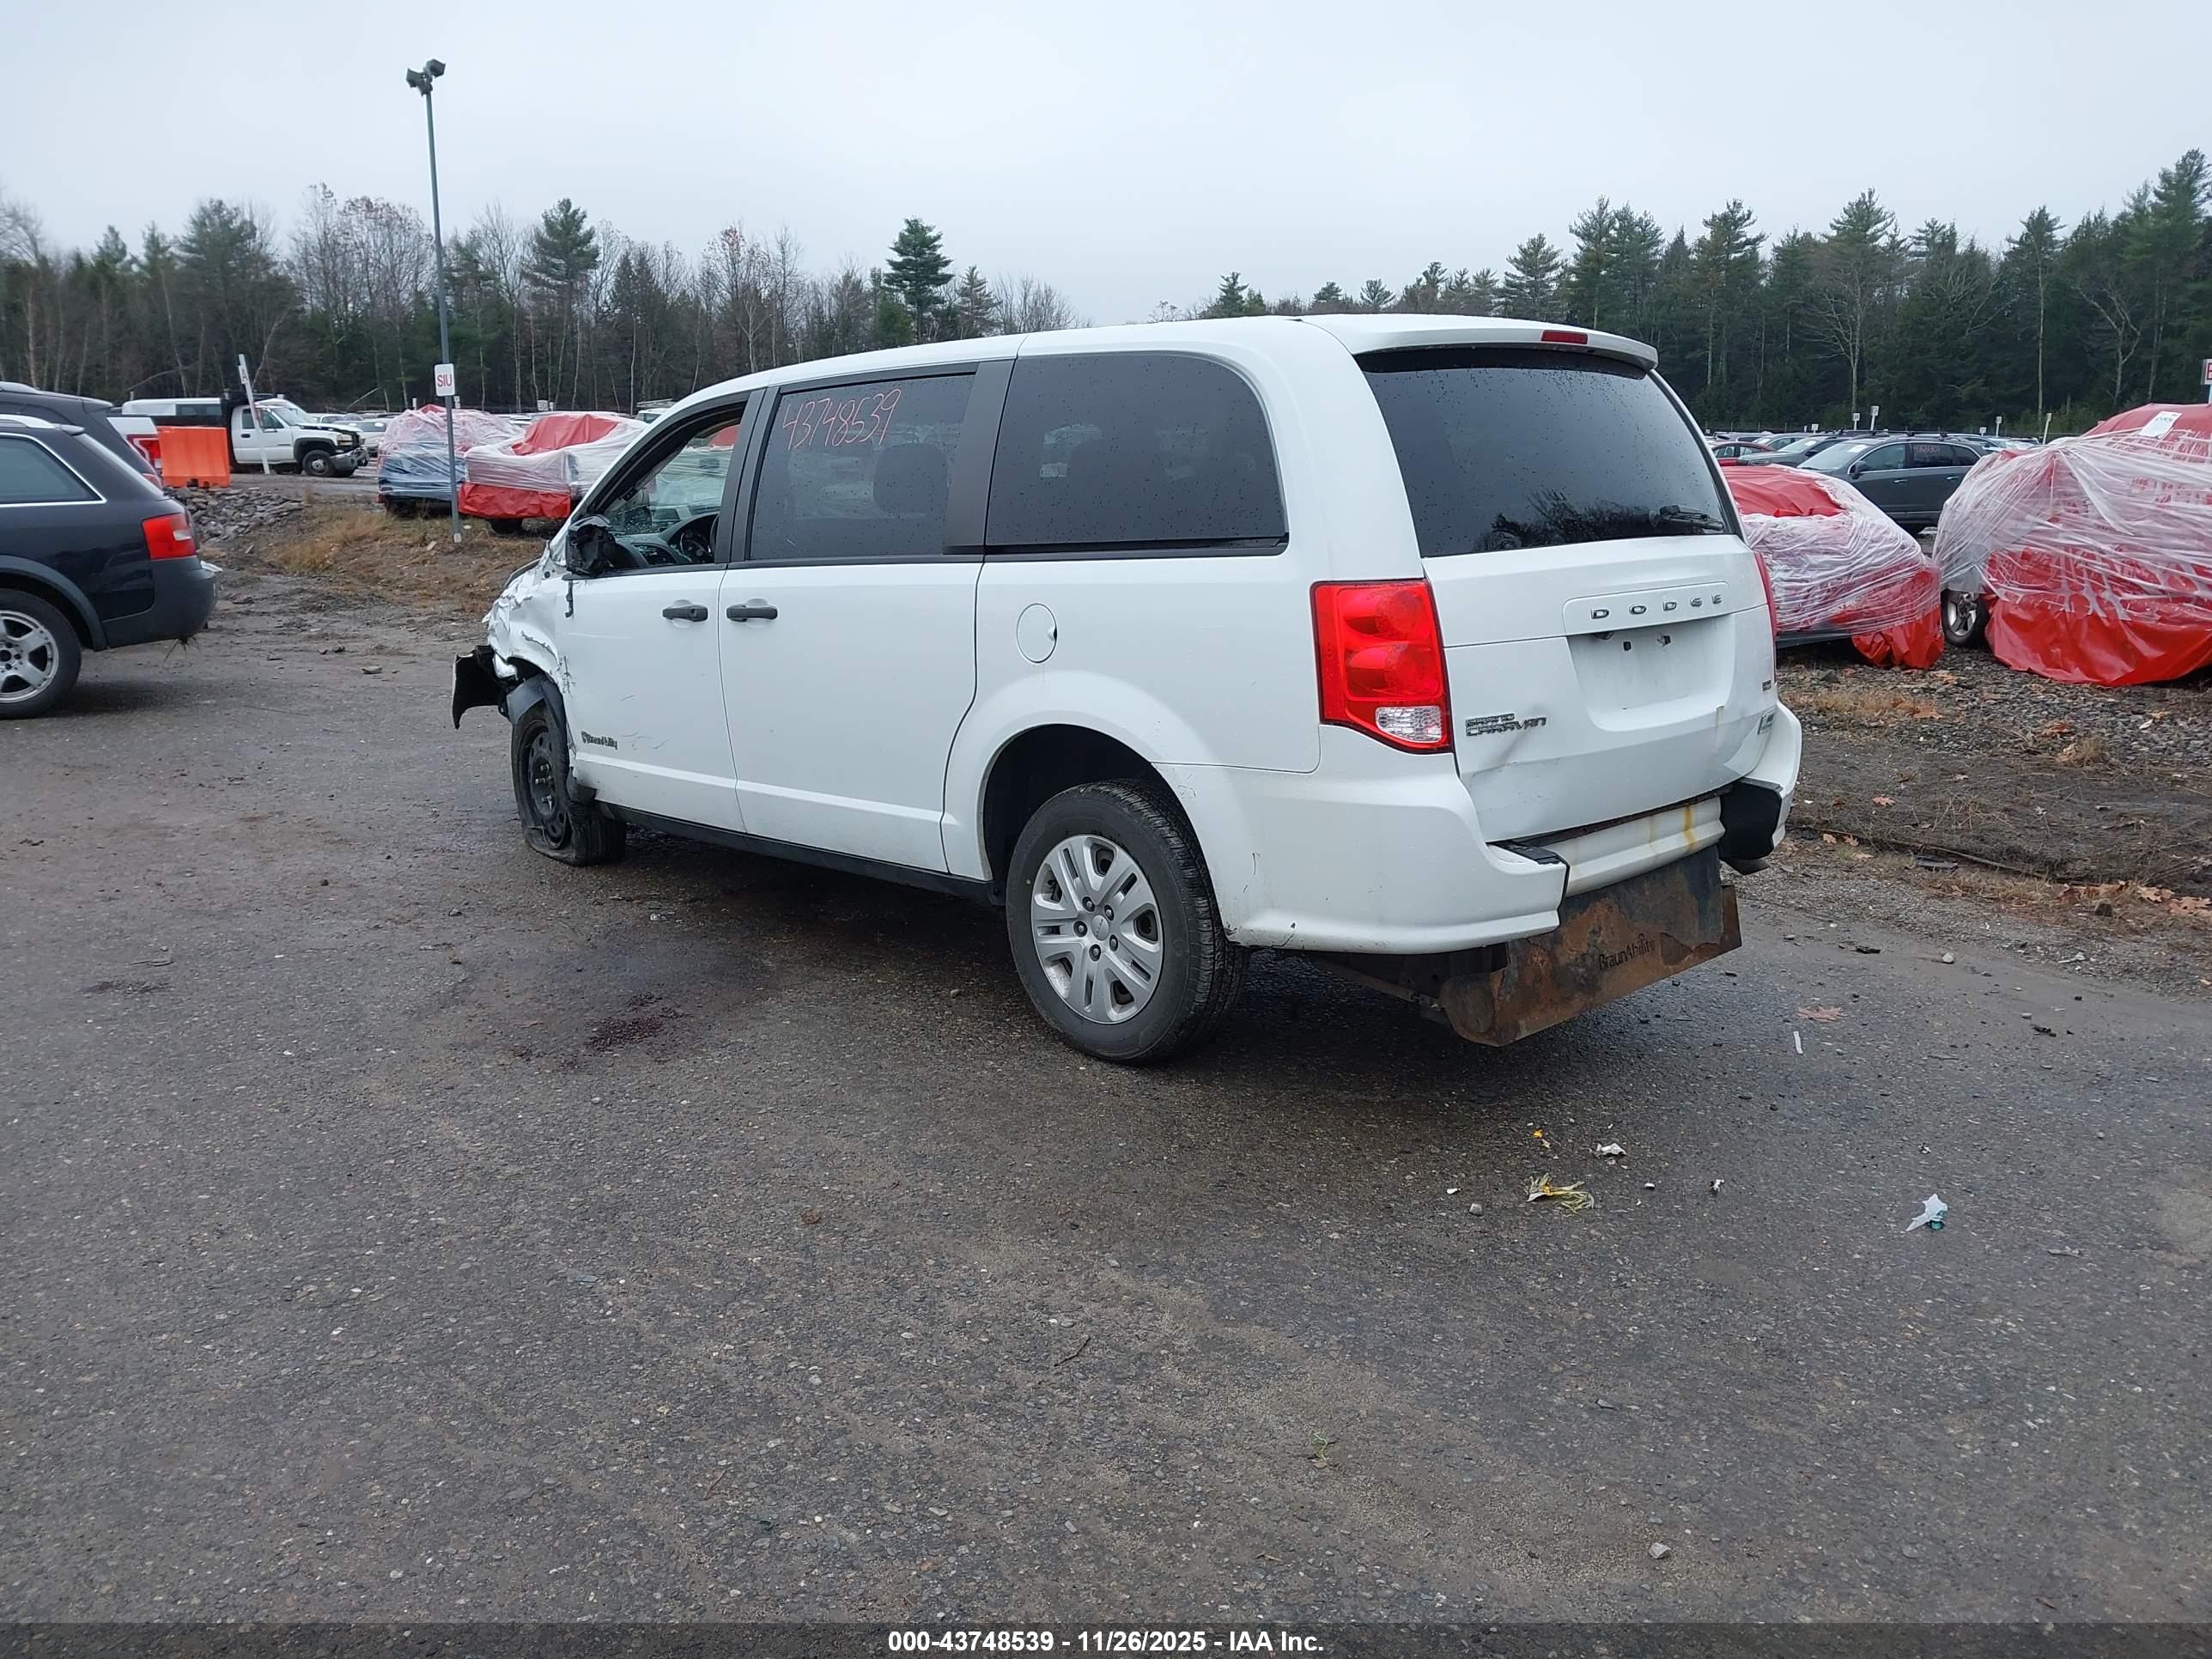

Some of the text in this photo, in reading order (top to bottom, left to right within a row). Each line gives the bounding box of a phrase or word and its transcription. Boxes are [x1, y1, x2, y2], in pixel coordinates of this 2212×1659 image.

[437, 374, 453, 387] SIU
[782, 388, 902, 451] 43748539
[1591, 594, 1723, 620] DODGE
